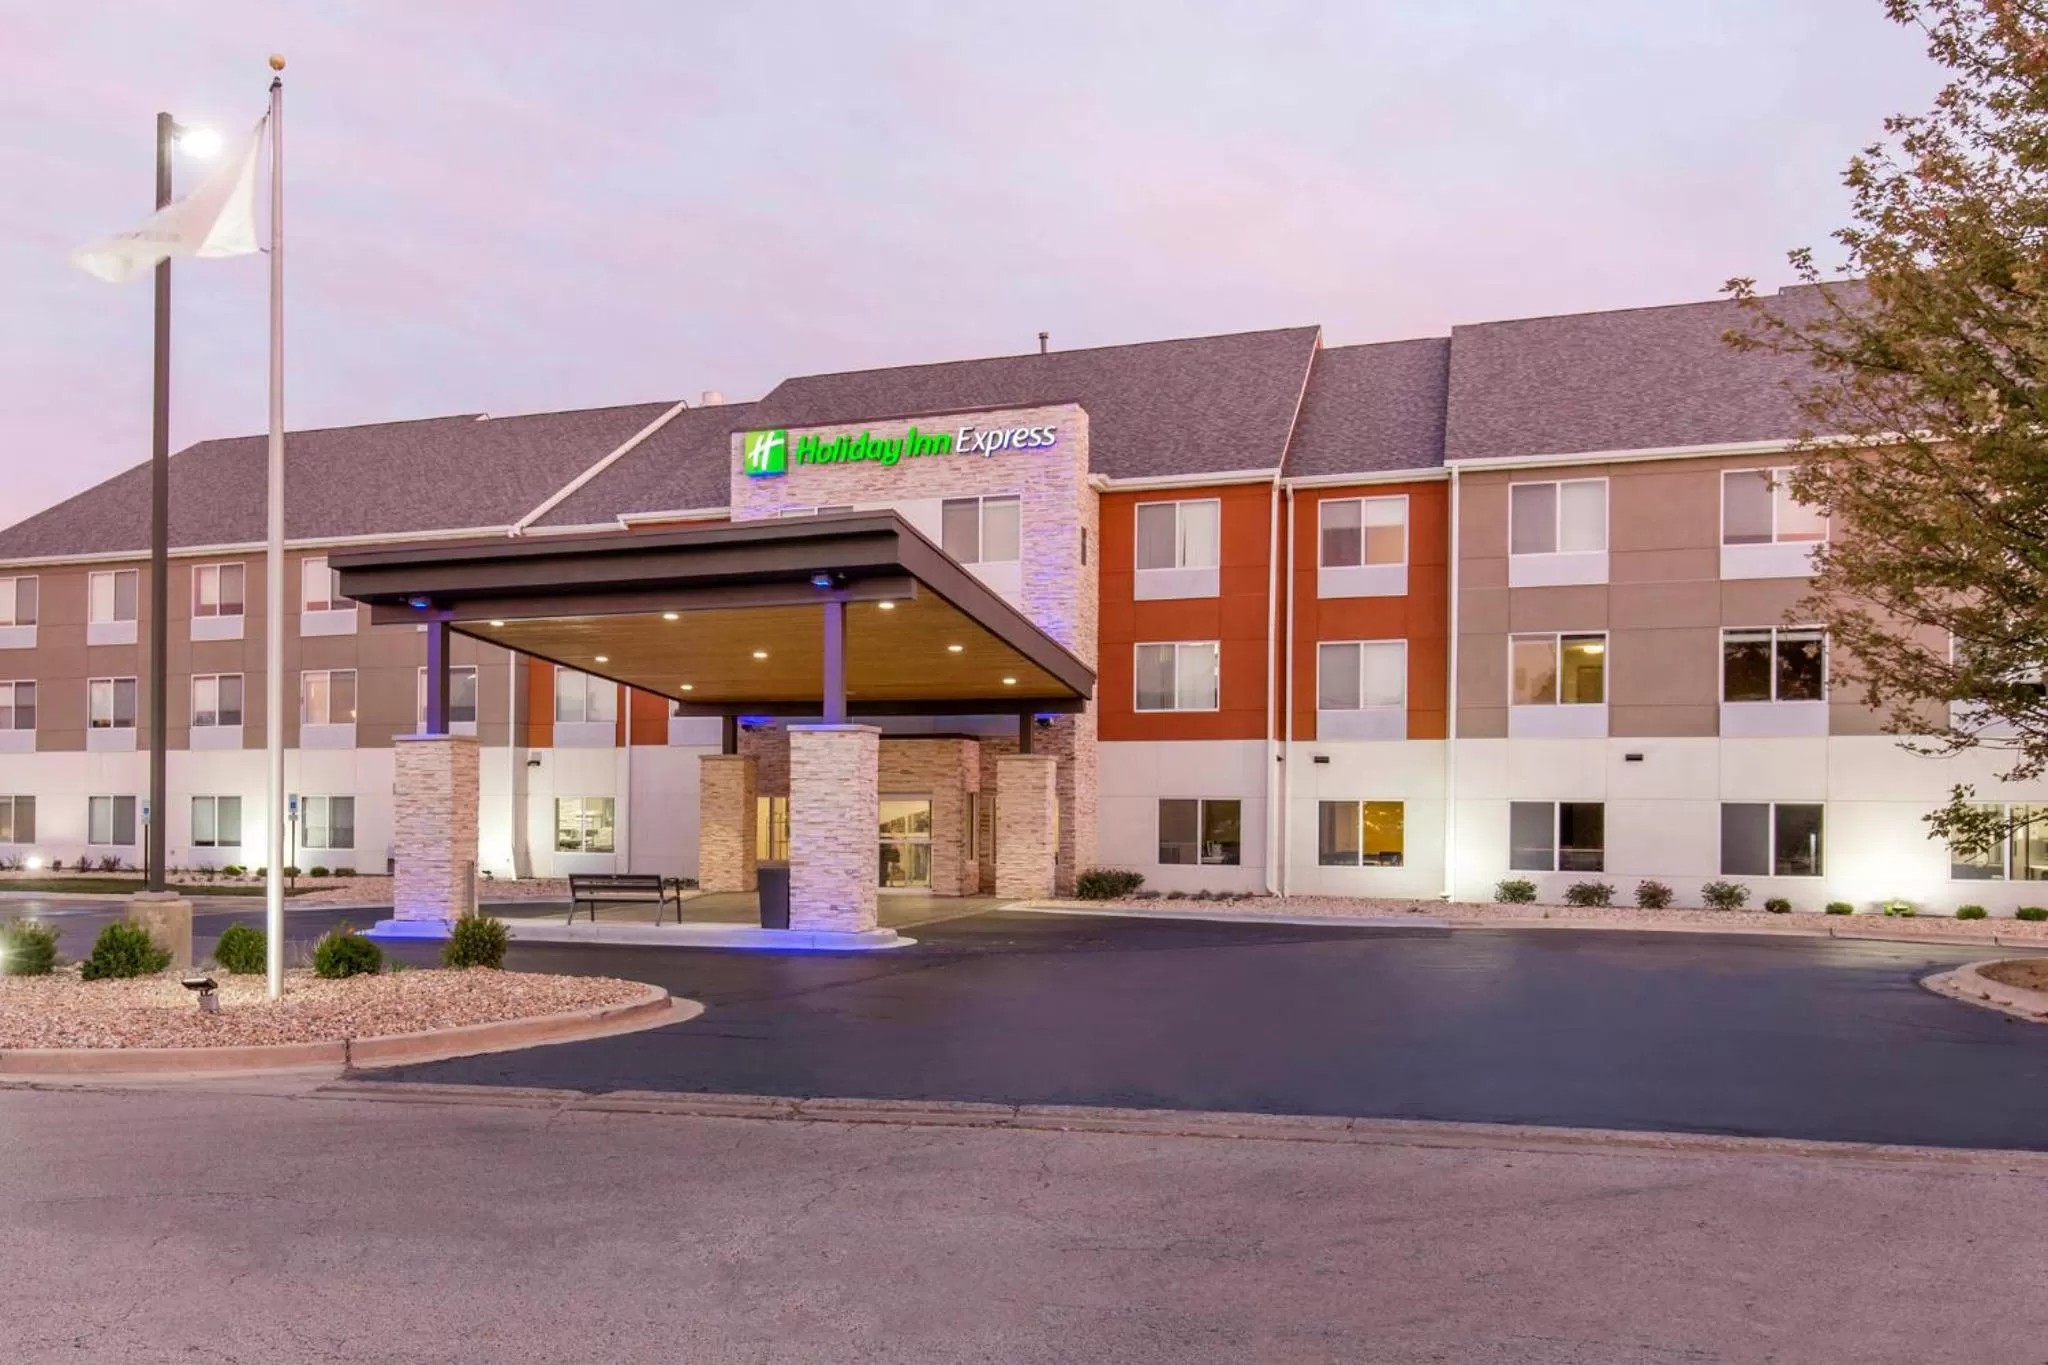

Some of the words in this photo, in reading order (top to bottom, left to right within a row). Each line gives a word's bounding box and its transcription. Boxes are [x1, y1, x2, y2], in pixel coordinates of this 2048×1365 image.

[796, 430, 903, 466] Holiday
[906, 425, 952, 457] Inn
[956, 426, 1057, 457] Express
